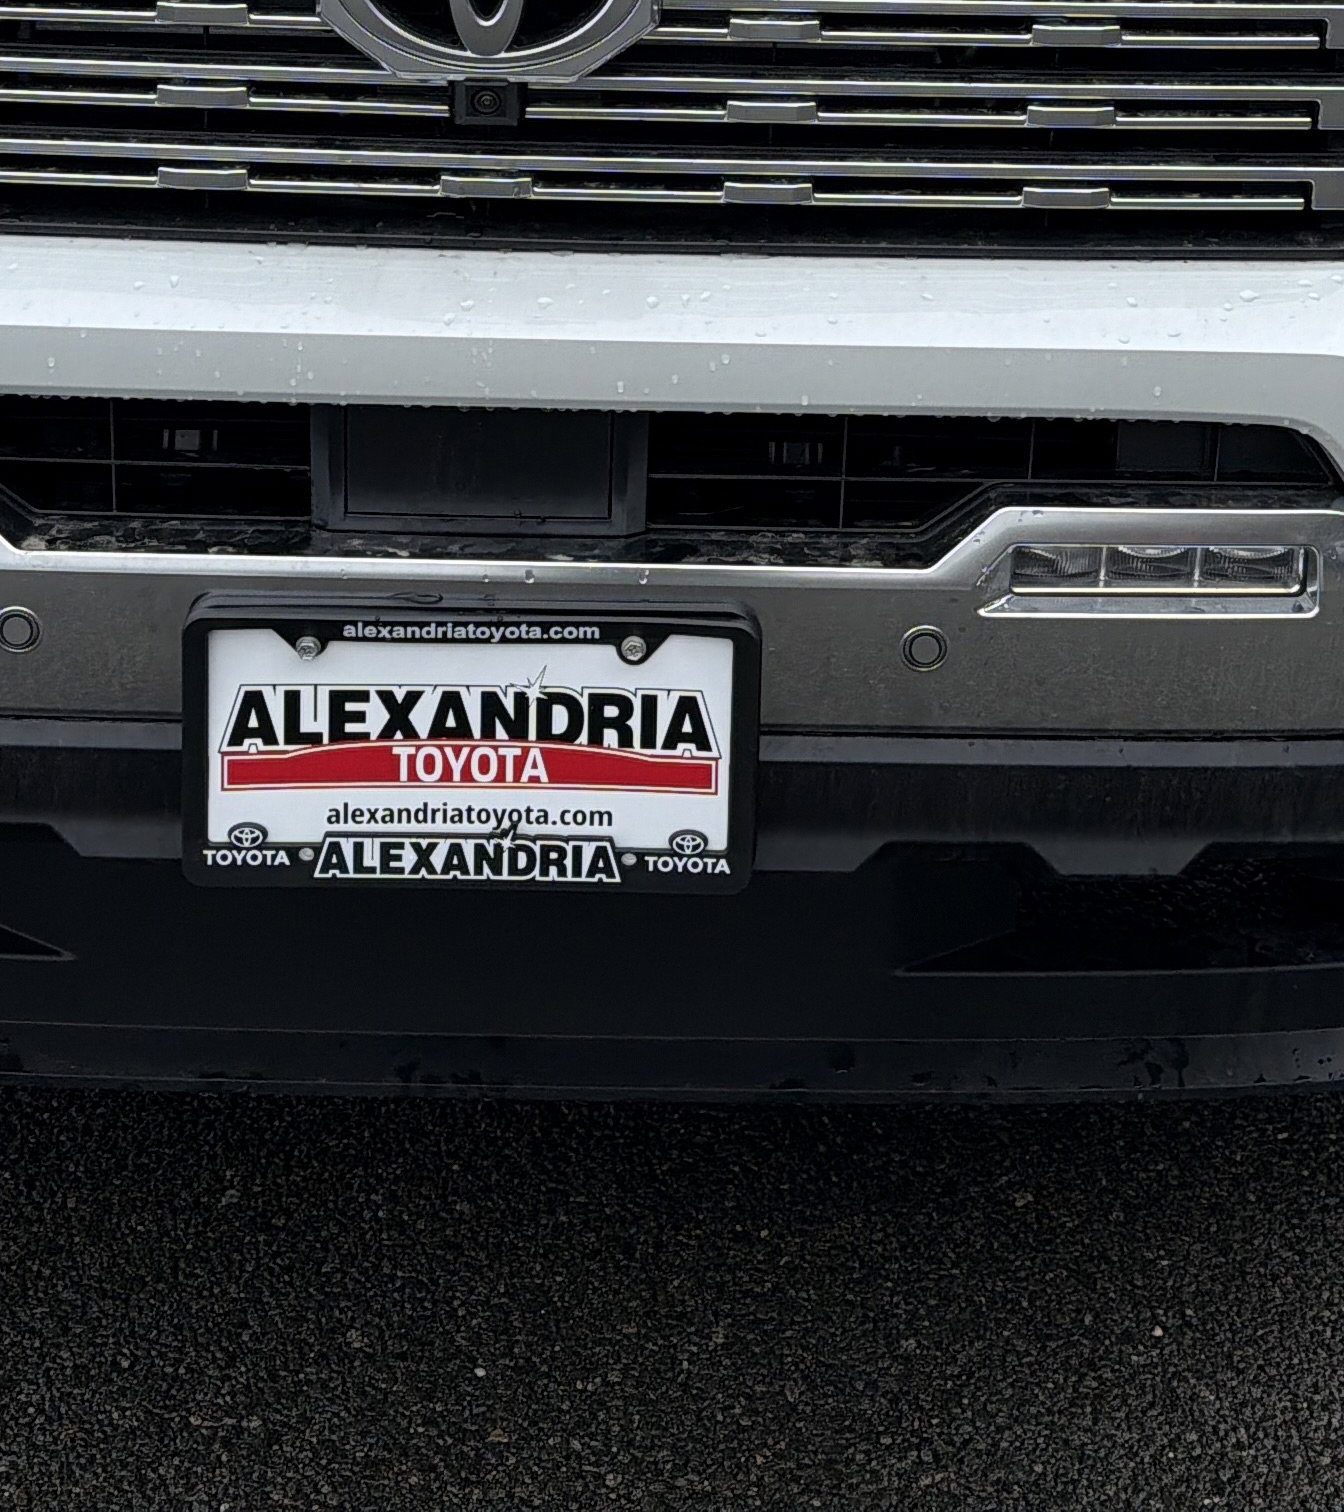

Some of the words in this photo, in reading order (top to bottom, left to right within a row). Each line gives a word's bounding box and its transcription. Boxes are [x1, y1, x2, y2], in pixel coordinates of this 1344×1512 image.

[342, 621, 601, 643] alexandriatoyota.com
[226, 688, 714, 752] ALEXANDRIA
[391, 745, 550, 784] TOYOTA
[325, 801, 614, 829] alexandriatoyota.com
[203, 848, 291, 867] TOYOTA
[314, 836, 621, 882] ALEXANDRIA
[644, 854, 731, 875] TOYOTA
